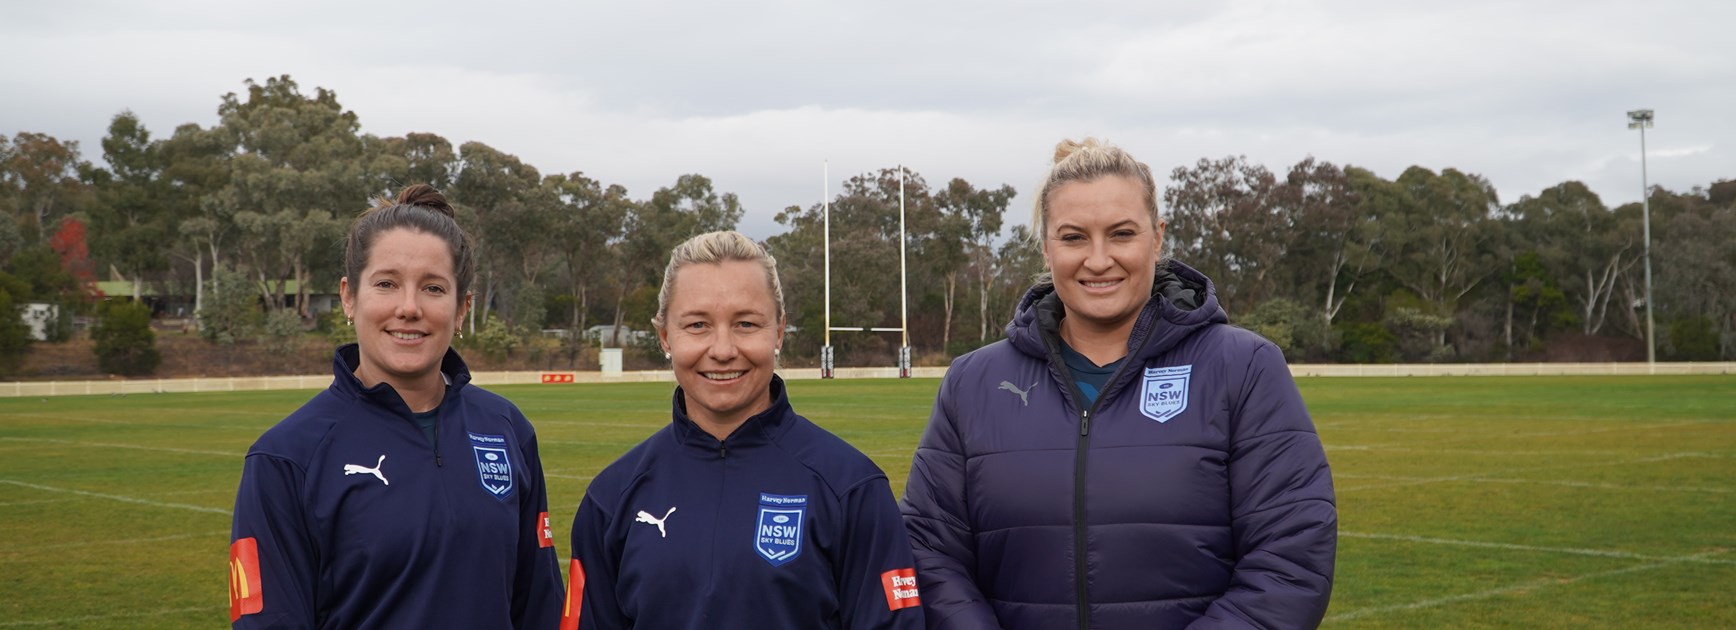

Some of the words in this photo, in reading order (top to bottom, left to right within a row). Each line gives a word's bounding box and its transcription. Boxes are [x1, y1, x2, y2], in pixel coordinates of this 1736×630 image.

[1148, 390, 1182, 401] NSW
[480, 461, 508, 474] NSW
[761, 524, 797, 538] NSW
[774, 538, 795, 546] BLUES
